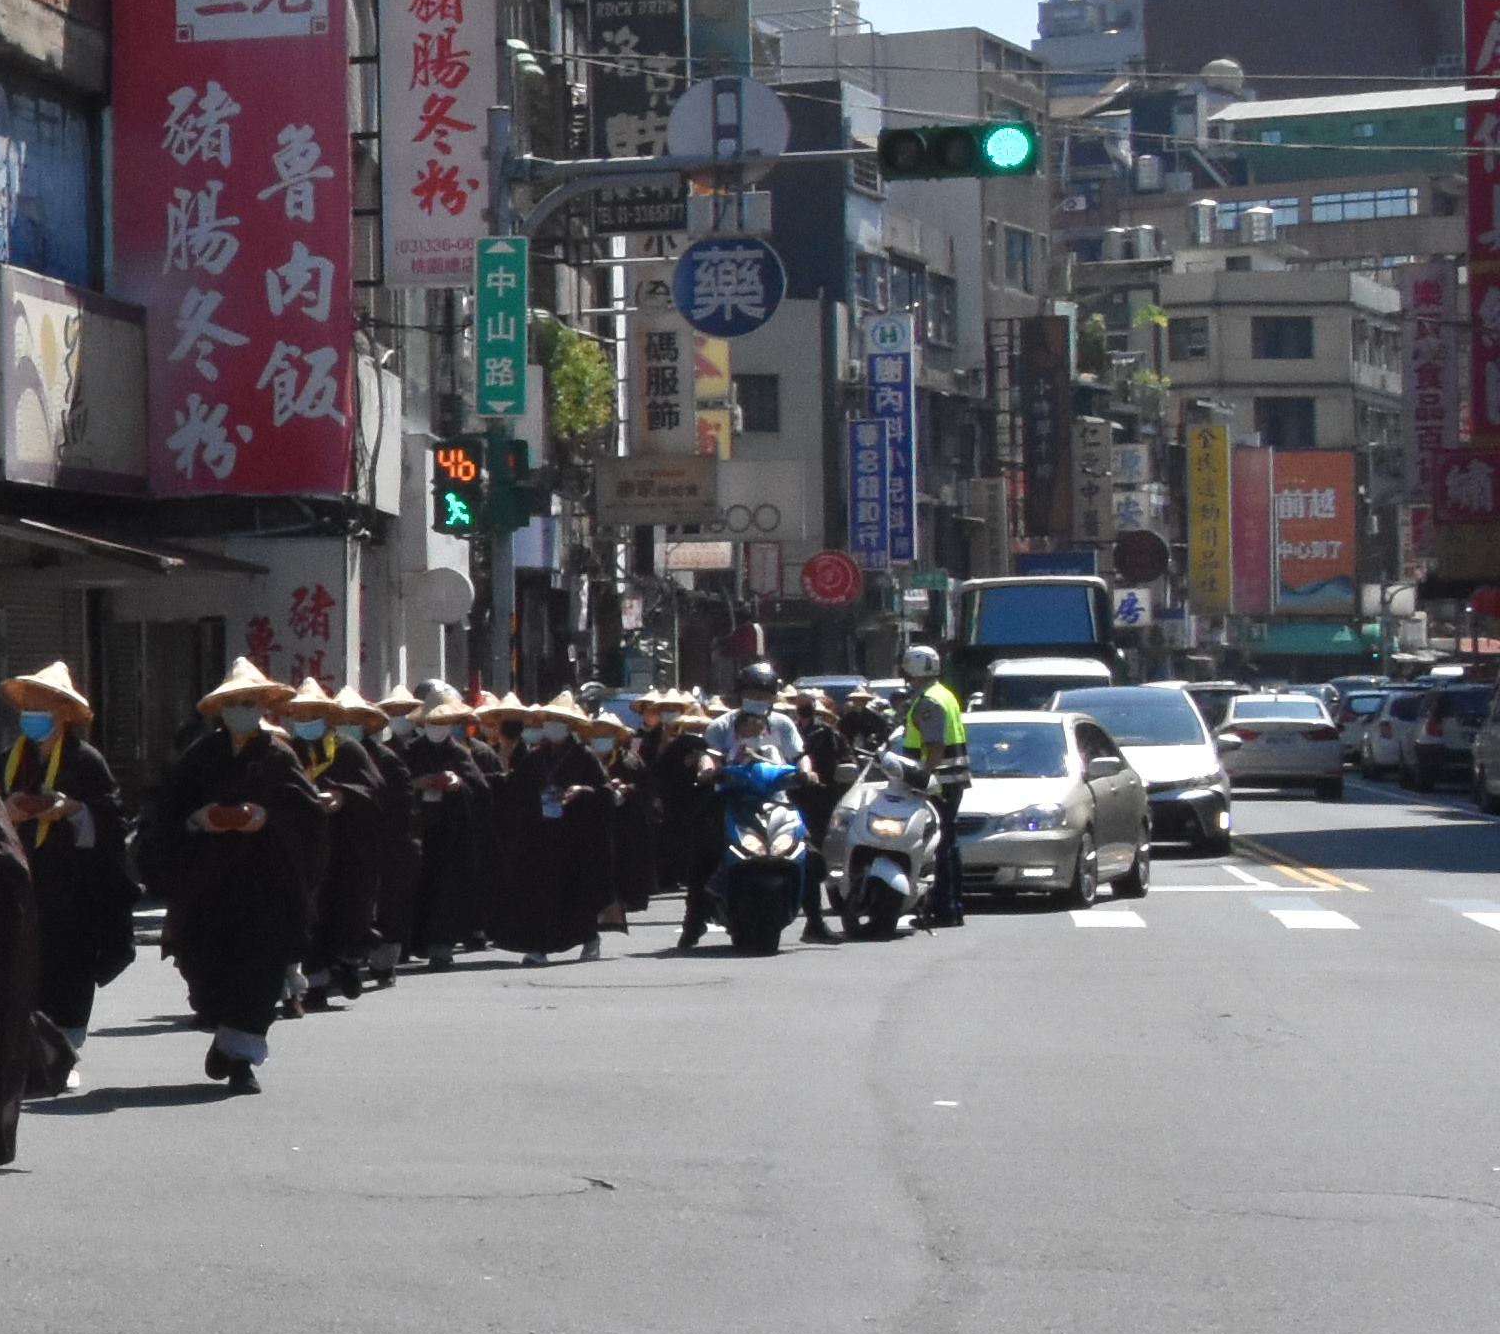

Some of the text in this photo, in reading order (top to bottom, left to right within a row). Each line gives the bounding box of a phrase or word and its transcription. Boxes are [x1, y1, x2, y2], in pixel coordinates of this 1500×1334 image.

[161, 80, 253, 482] 豬腸冬粉
[256, 123, 346, 428] 魯肉飯
[485, 265, 516, 386] 中山路
[691, 248, 768, 322] 藥
[438, 448, 476, 482] 46
